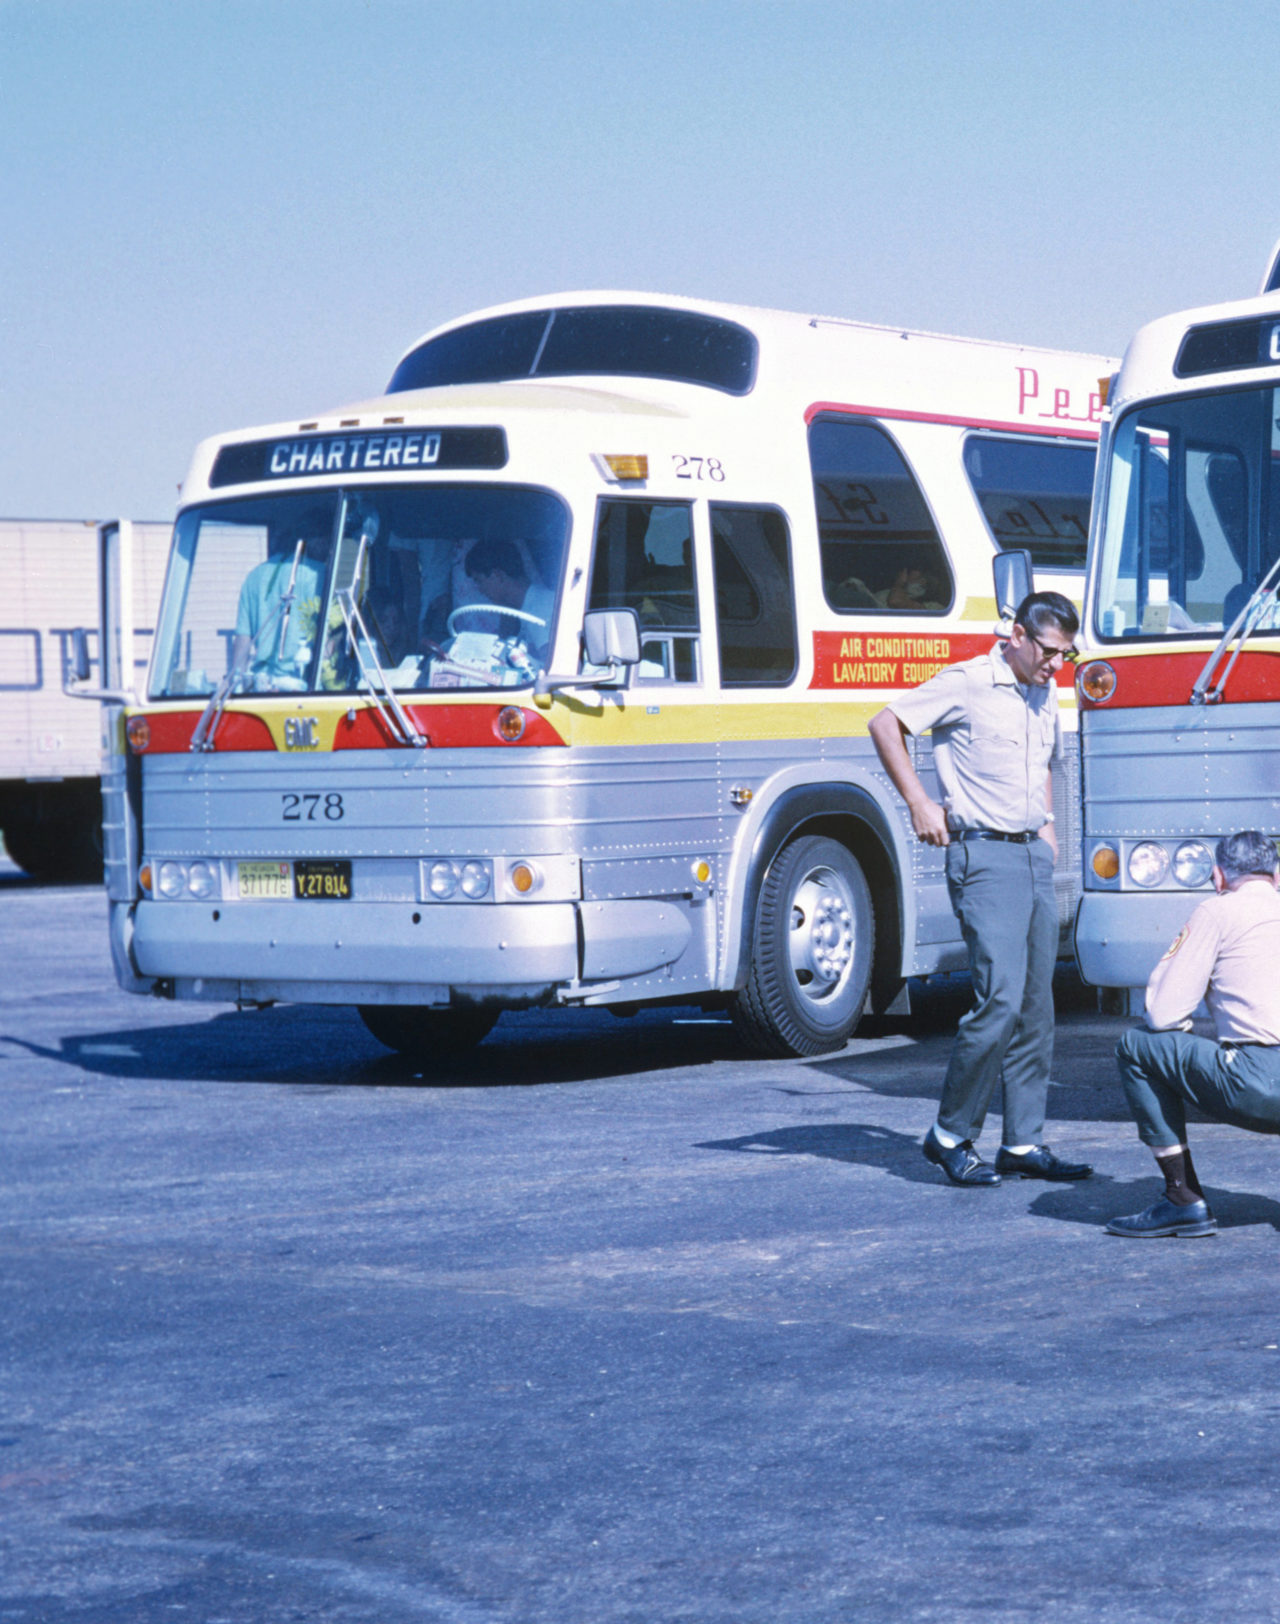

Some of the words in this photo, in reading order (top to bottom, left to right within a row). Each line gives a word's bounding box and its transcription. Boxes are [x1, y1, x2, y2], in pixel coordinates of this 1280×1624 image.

[270, 433, 442, 474] CHARTERED
[671, 454, 726, 482] 278
[840, 638, 862, 658] AIR
[866, 638, 950, 658] CONDITIONED
[833, 663, 897, 682] LAVATORY
[903, 663, 949, 684] EQUIPP
[284, 717, 319, 747] GMC
[282, 792, 345, 821] 278
